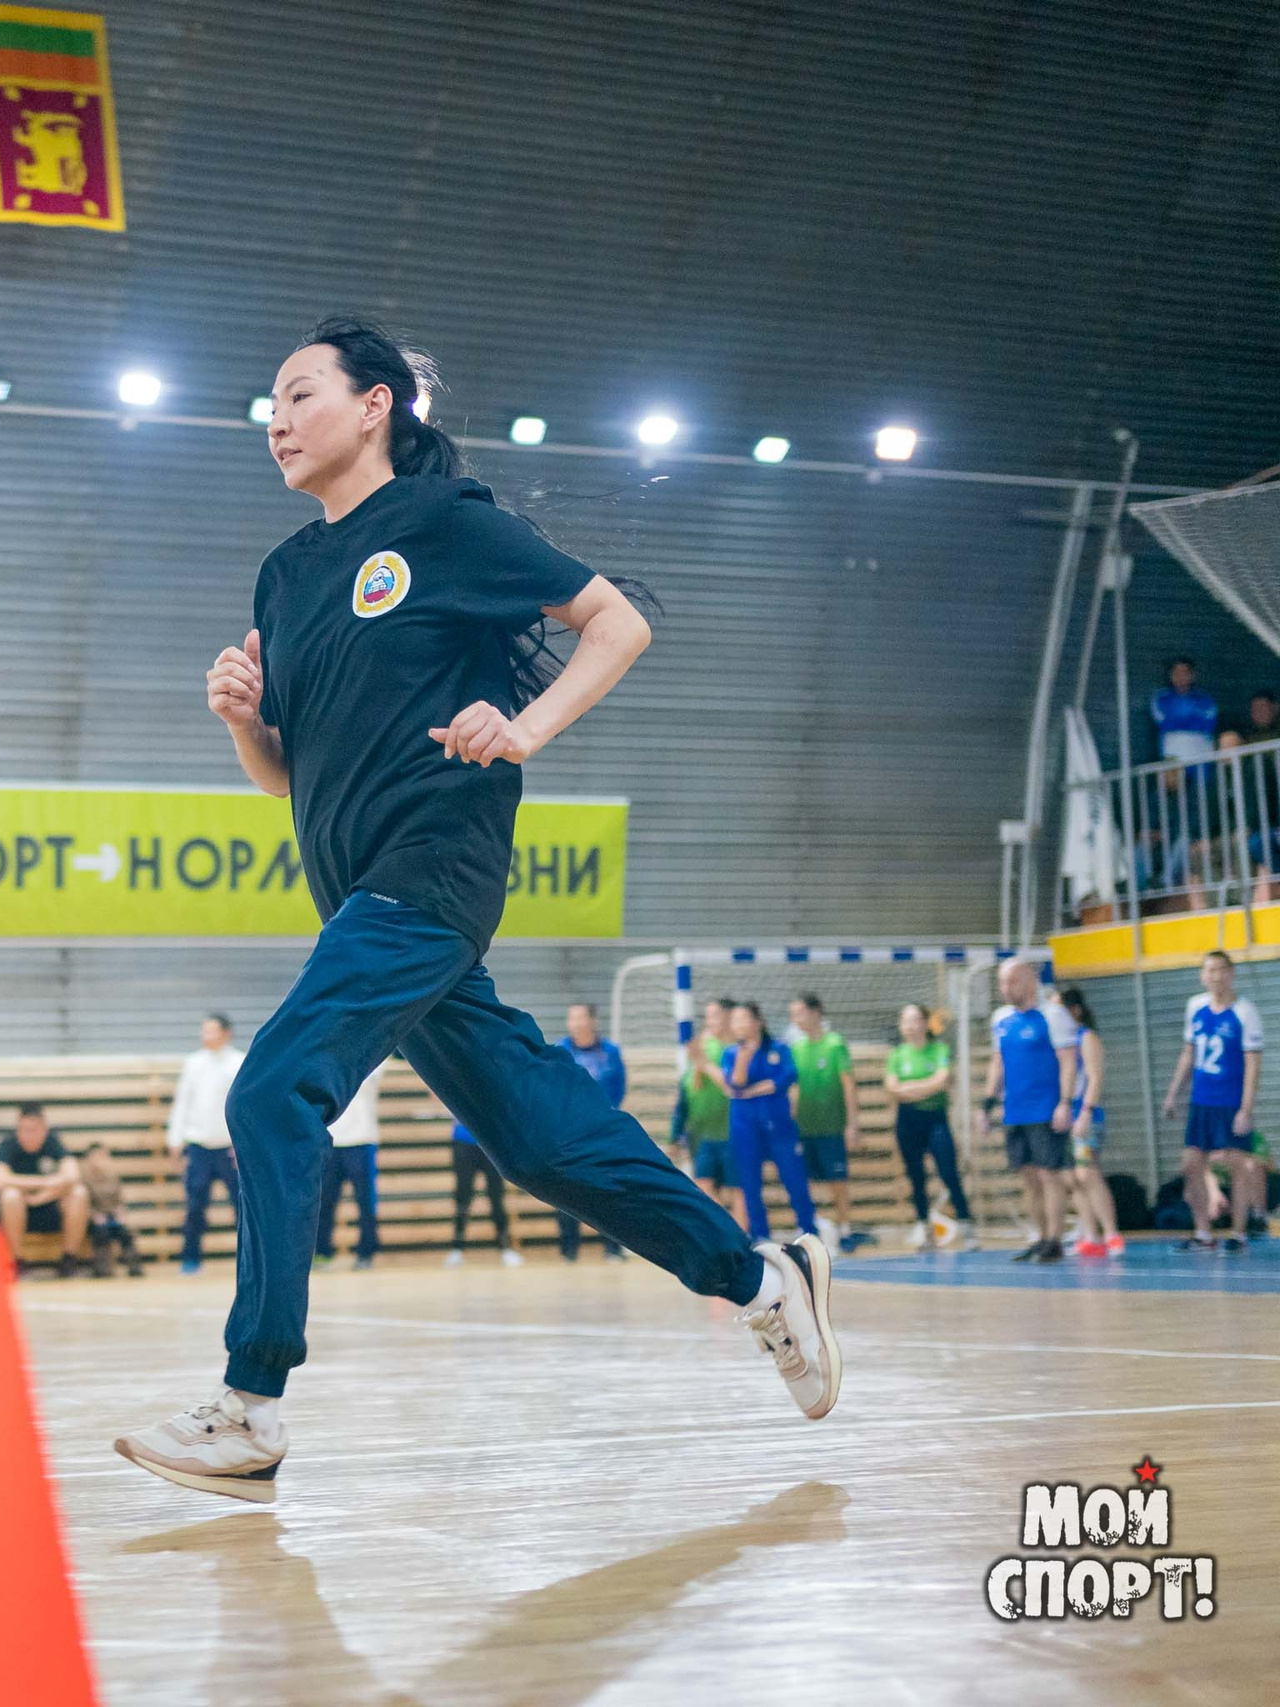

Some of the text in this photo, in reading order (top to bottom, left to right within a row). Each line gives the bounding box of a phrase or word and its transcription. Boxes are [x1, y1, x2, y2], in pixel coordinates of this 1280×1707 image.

[127, 836, 303, 892] НОРМ
[505, 846, 601, 895] ЗНИ
[370, 892, 399, 905] DEMIX
[1194, 1033, 1224, 1075] 12
